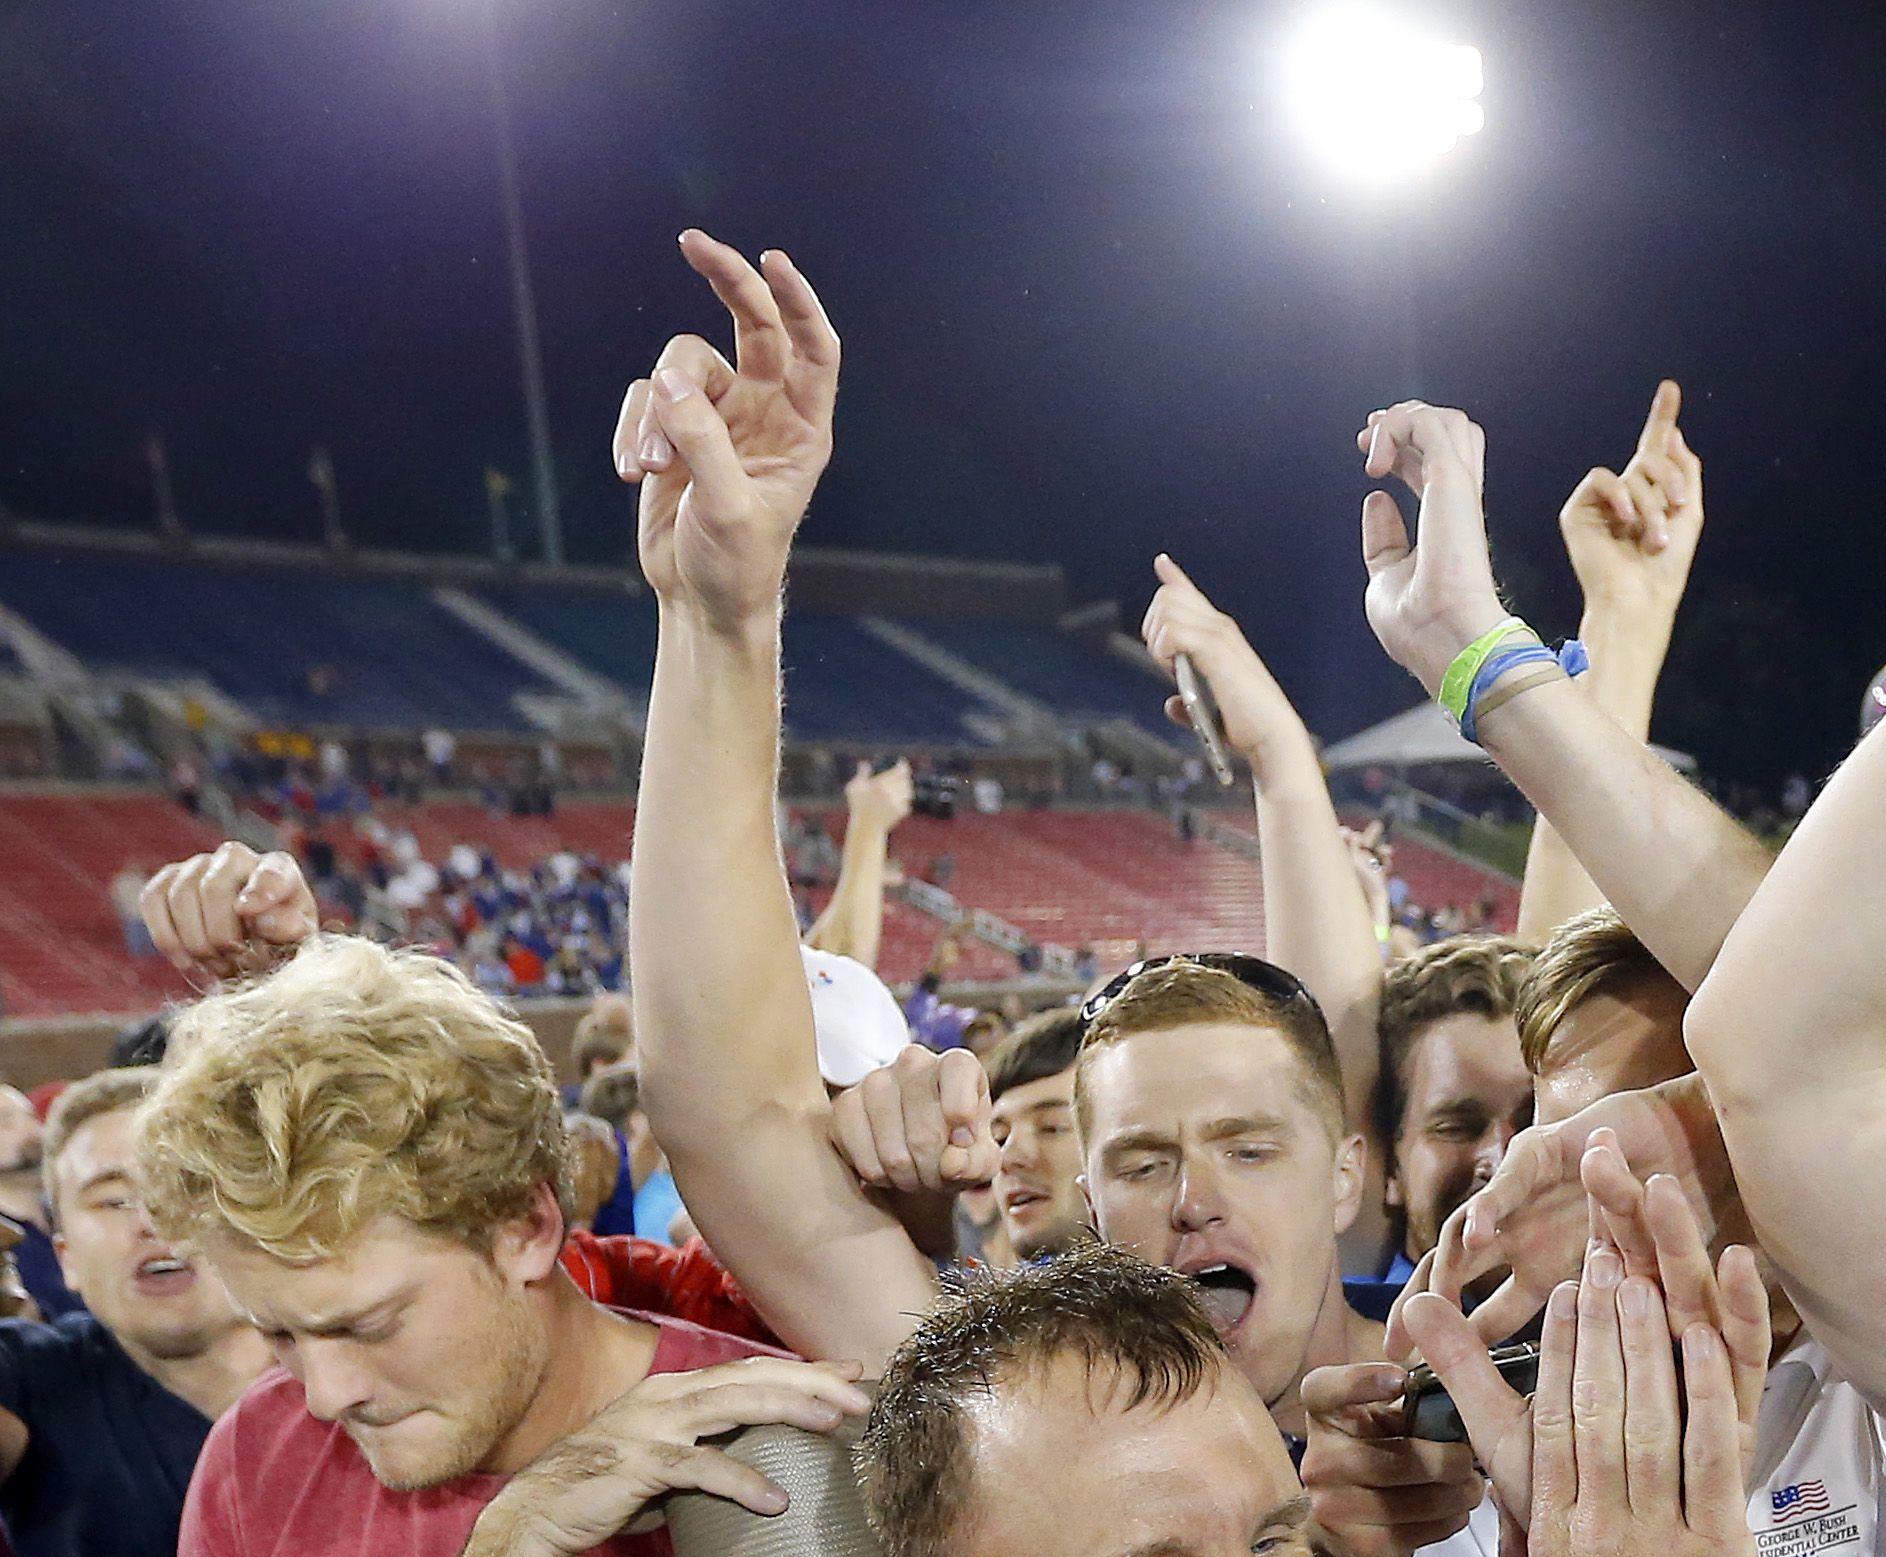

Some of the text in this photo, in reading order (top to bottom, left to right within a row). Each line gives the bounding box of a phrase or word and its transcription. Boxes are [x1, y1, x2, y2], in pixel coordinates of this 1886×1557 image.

[1758, 1514, 1847, 1548] GEORGE W. BUSH
[1818, 1525, 1860, 1545] CENTER
